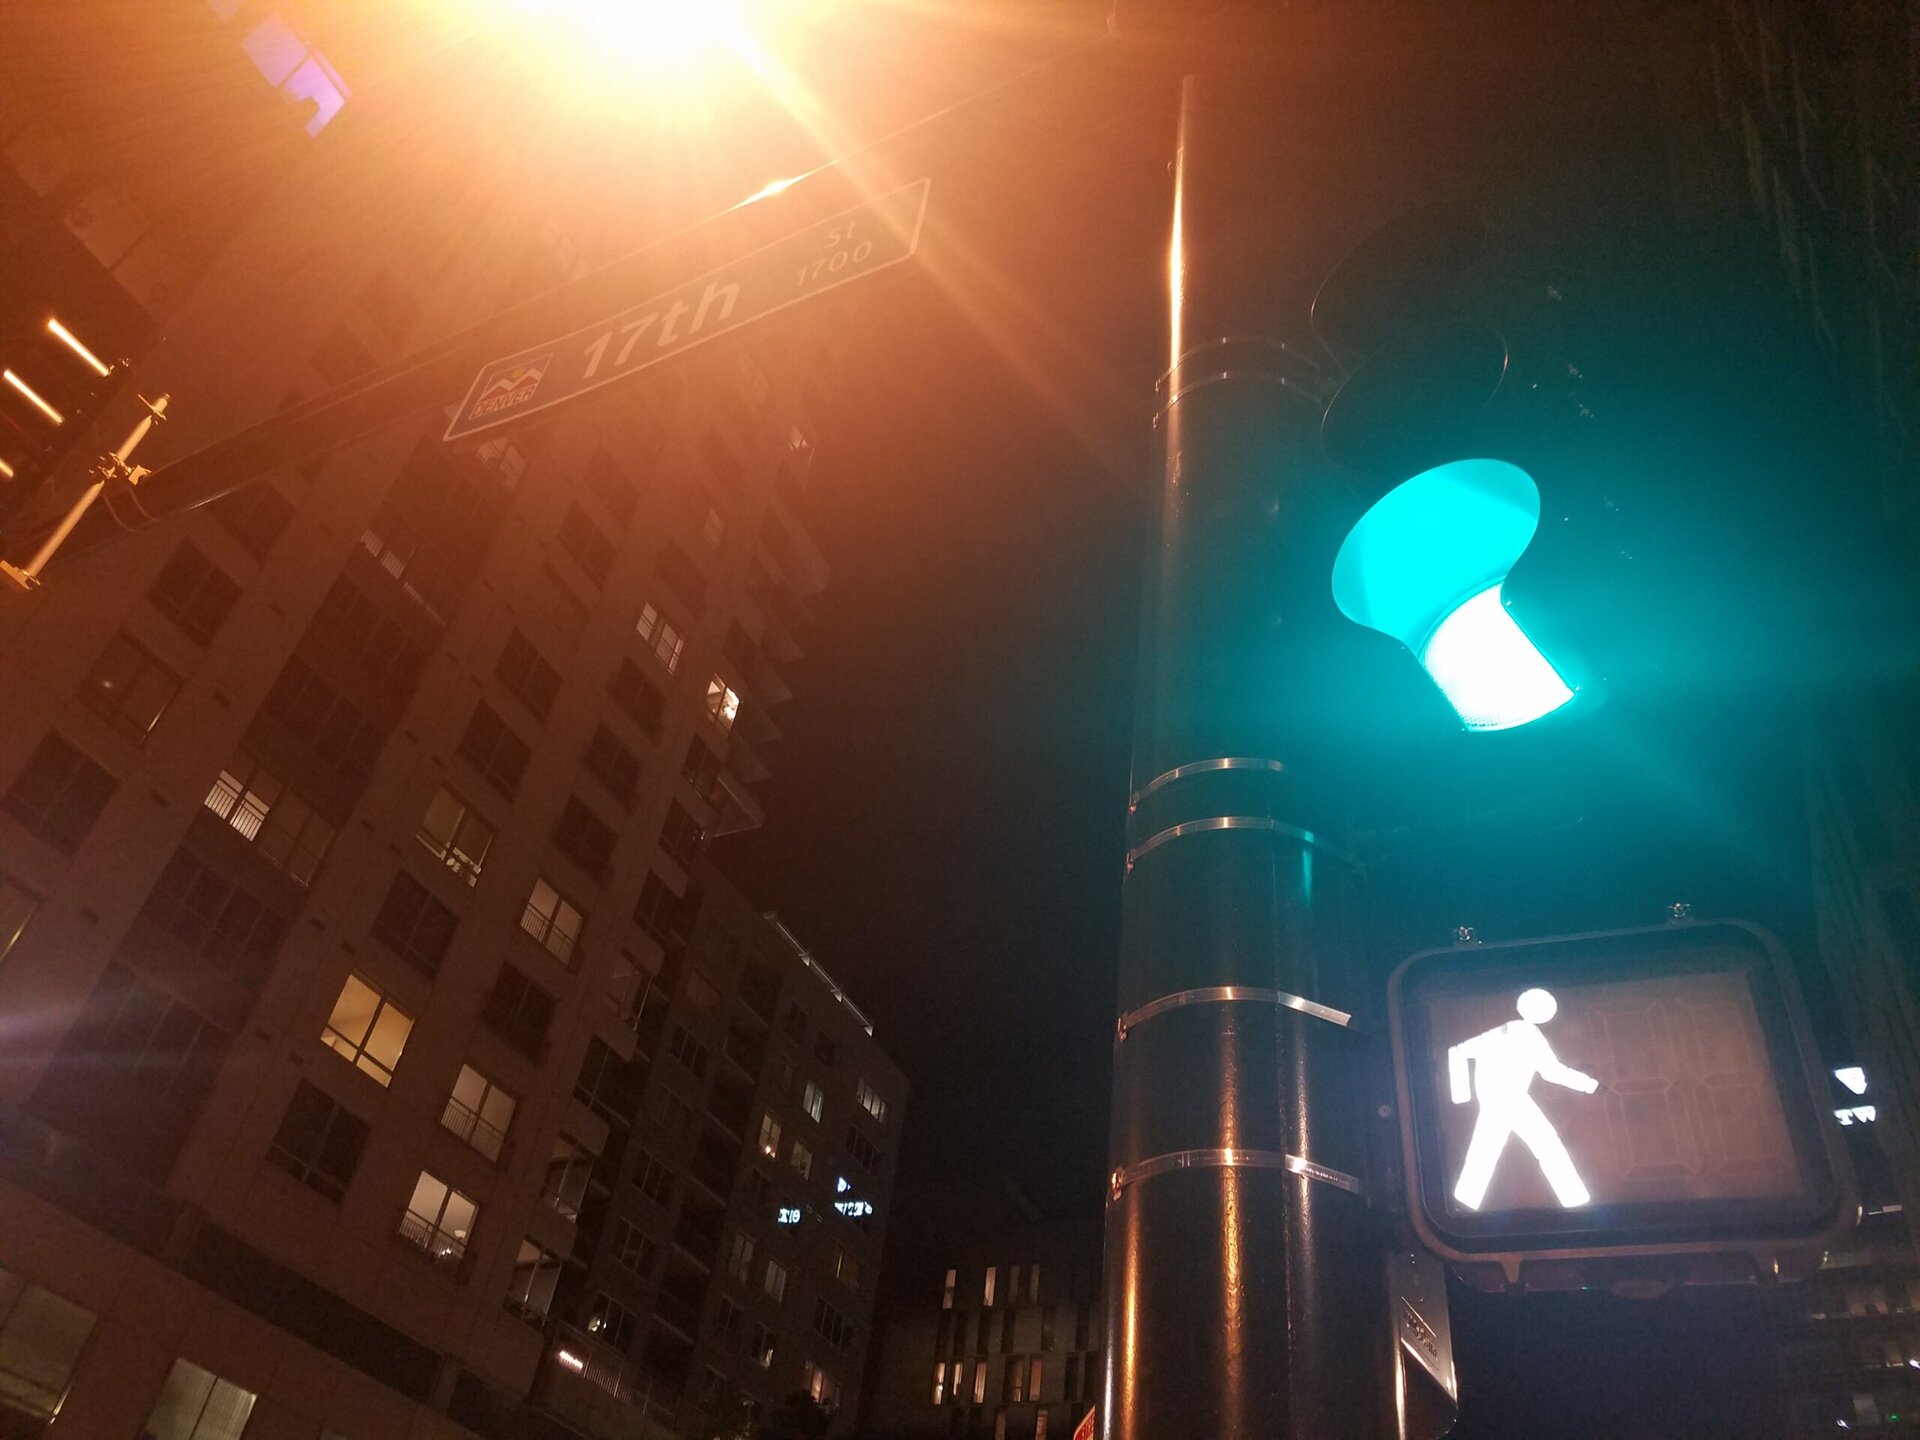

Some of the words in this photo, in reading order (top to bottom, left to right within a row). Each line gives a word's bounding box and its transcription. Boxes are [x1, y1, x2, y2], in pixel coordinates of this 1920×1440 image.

[796, 240, 874, 288] 1700
[582, 278, 742, 380] 17th
[824, 220, 856, 250] St
[472, 385, 536, 418] DENVER
